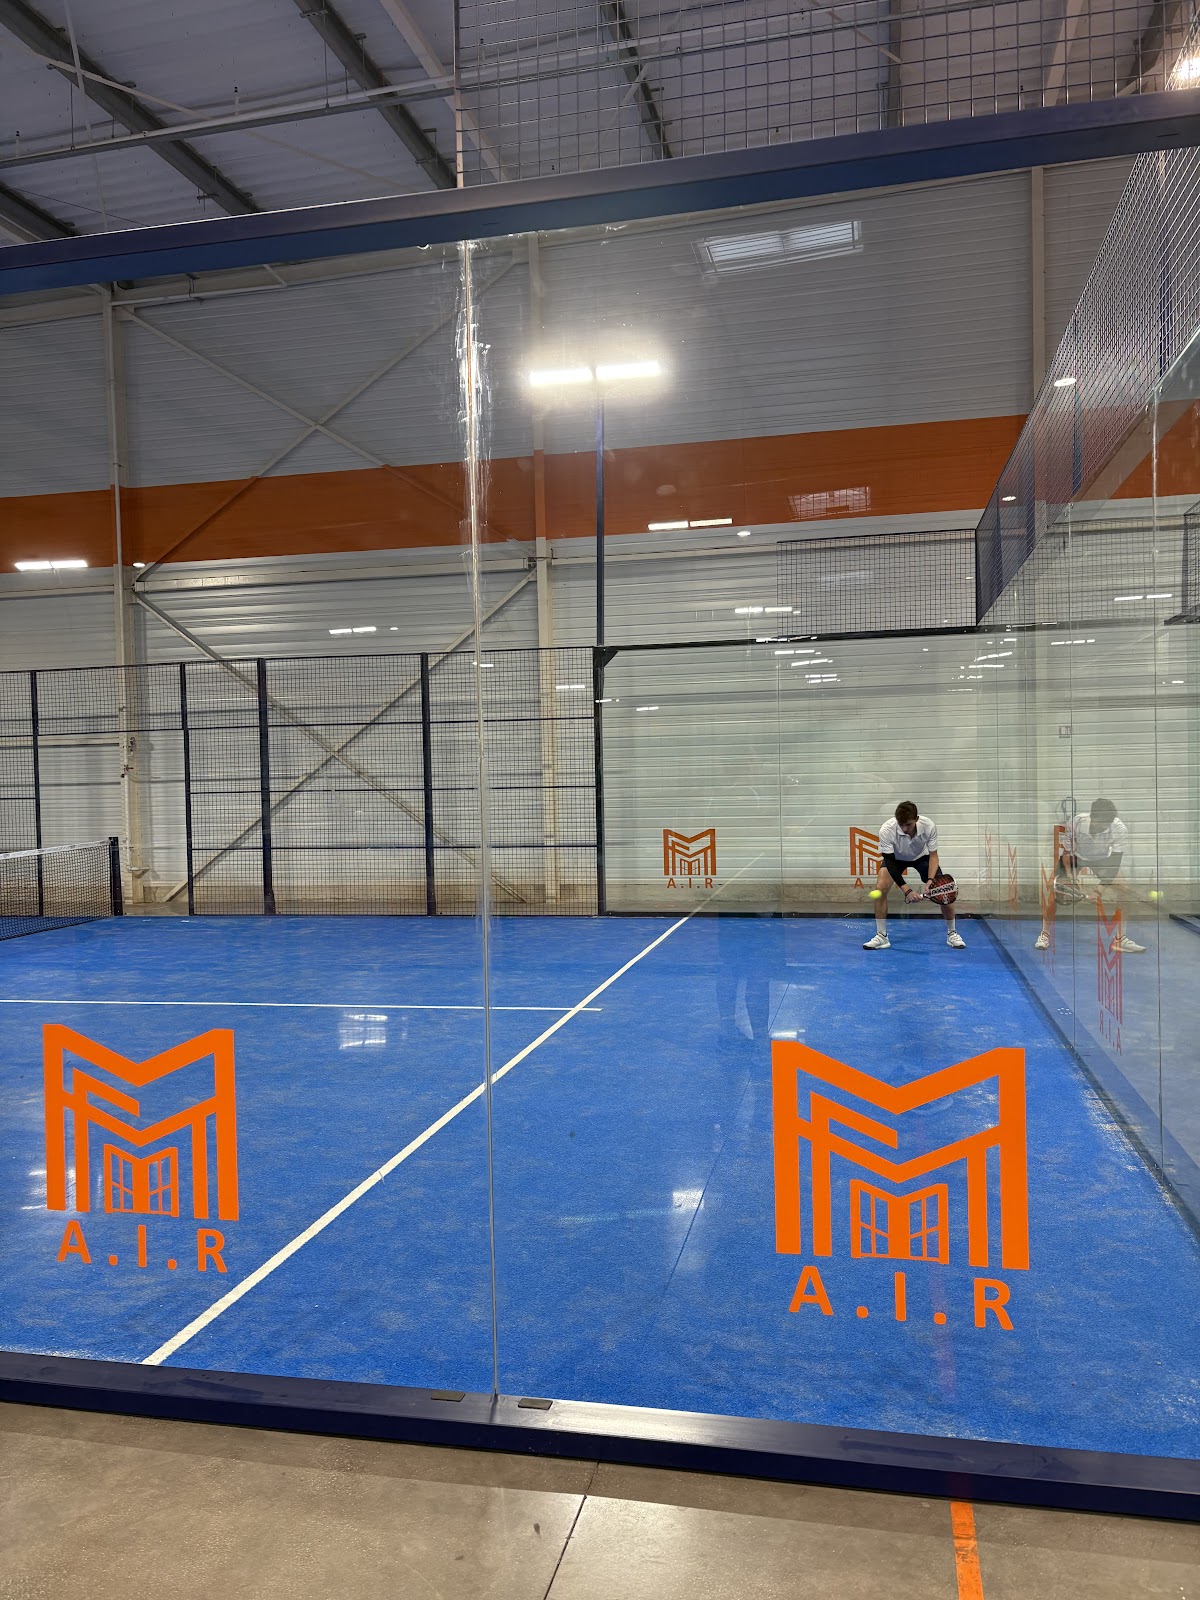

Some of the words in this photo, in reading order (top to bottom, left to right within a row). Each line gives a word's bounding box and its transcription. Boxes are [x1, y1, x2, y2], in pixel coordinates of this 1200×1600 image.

[667, 878, 713, 889] A.I.R
[56, 1220, 227, 1273] A.I.R
[788, 1265, 1014, 1330] A.I.R
